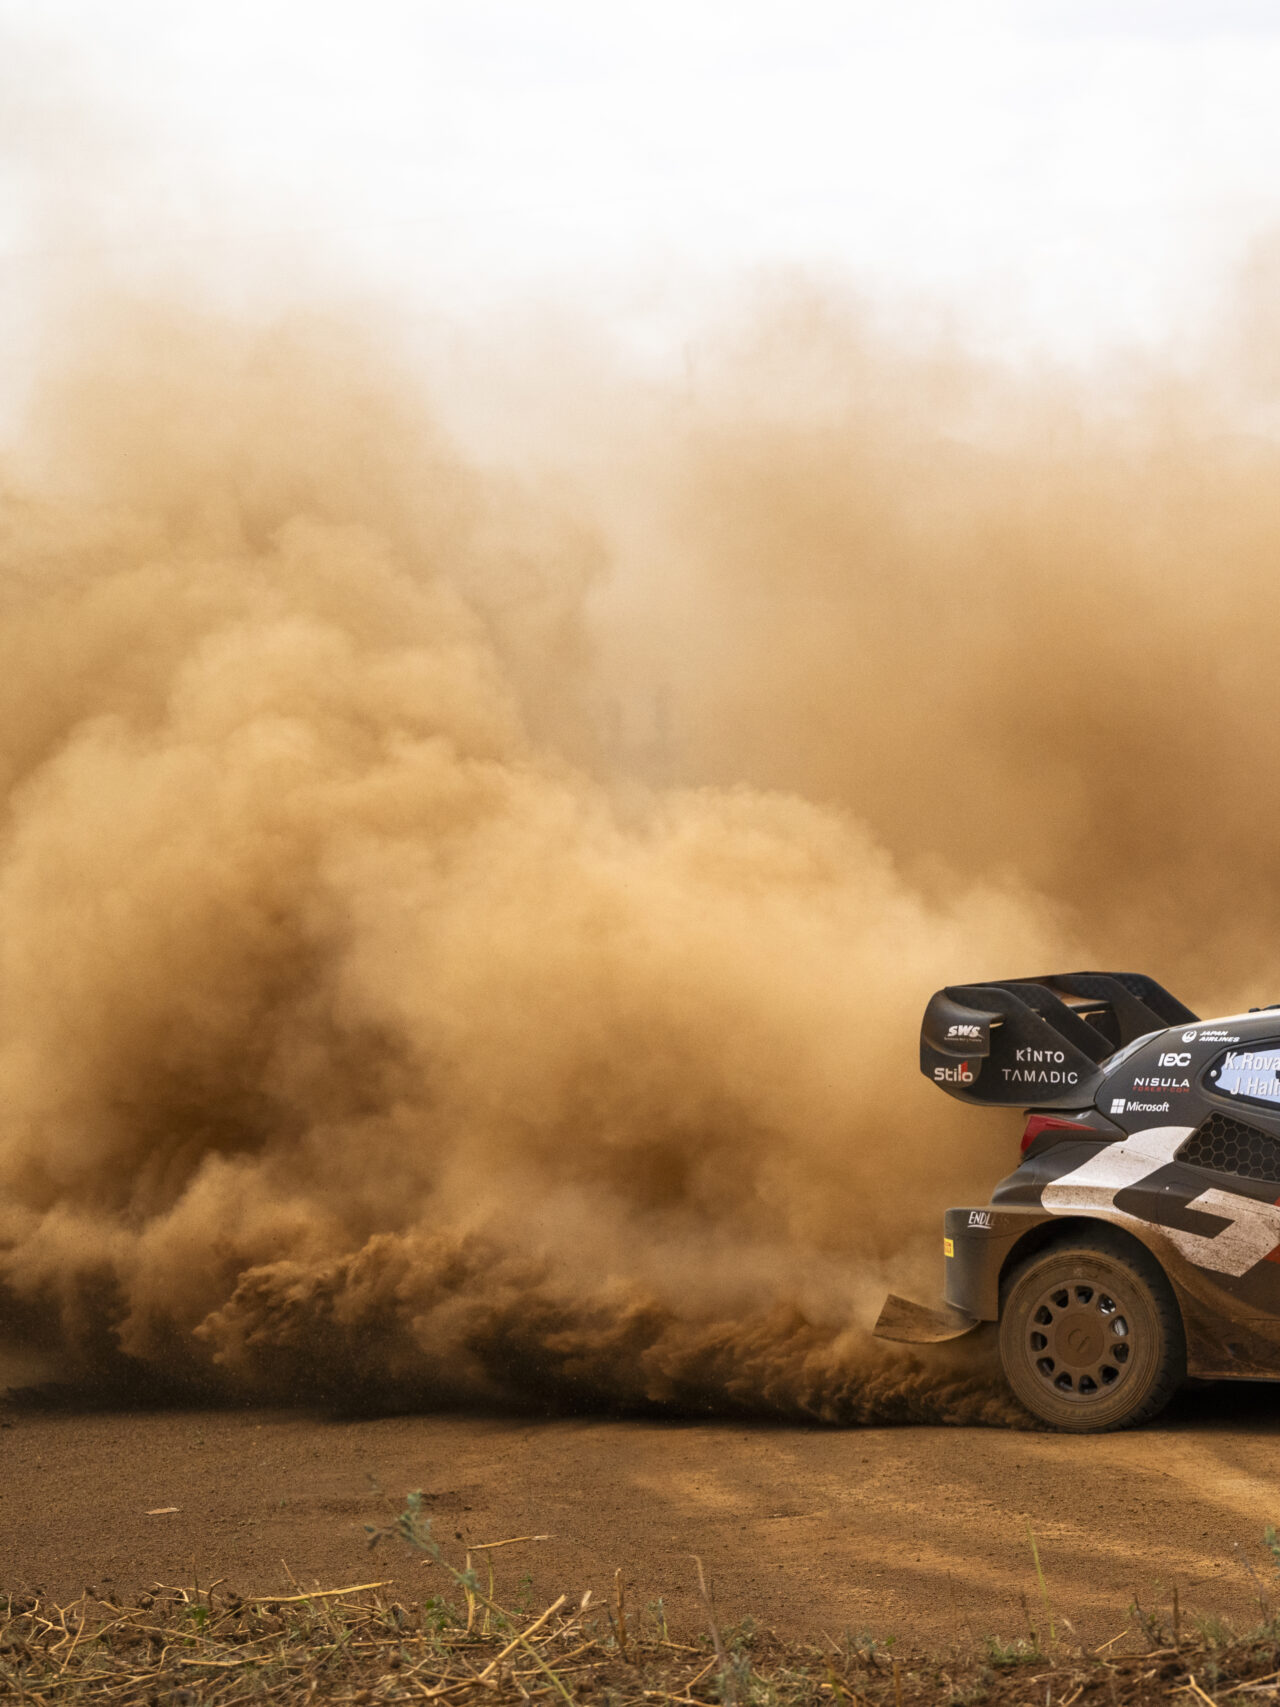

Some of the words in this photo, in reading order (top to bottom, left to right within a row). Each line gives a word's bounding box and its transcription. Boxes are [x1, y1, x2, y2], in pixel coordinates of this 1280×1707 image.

[947, 1025, 981, 1038] SWS
[934, 1061, 974, 1082] Stilo
[1002, 1069, 1078, 1084] TAMADIC
[1134, 1077, 1190, 1088] NISULA
[1126, 1101, 1170, 1113] Microsoft
